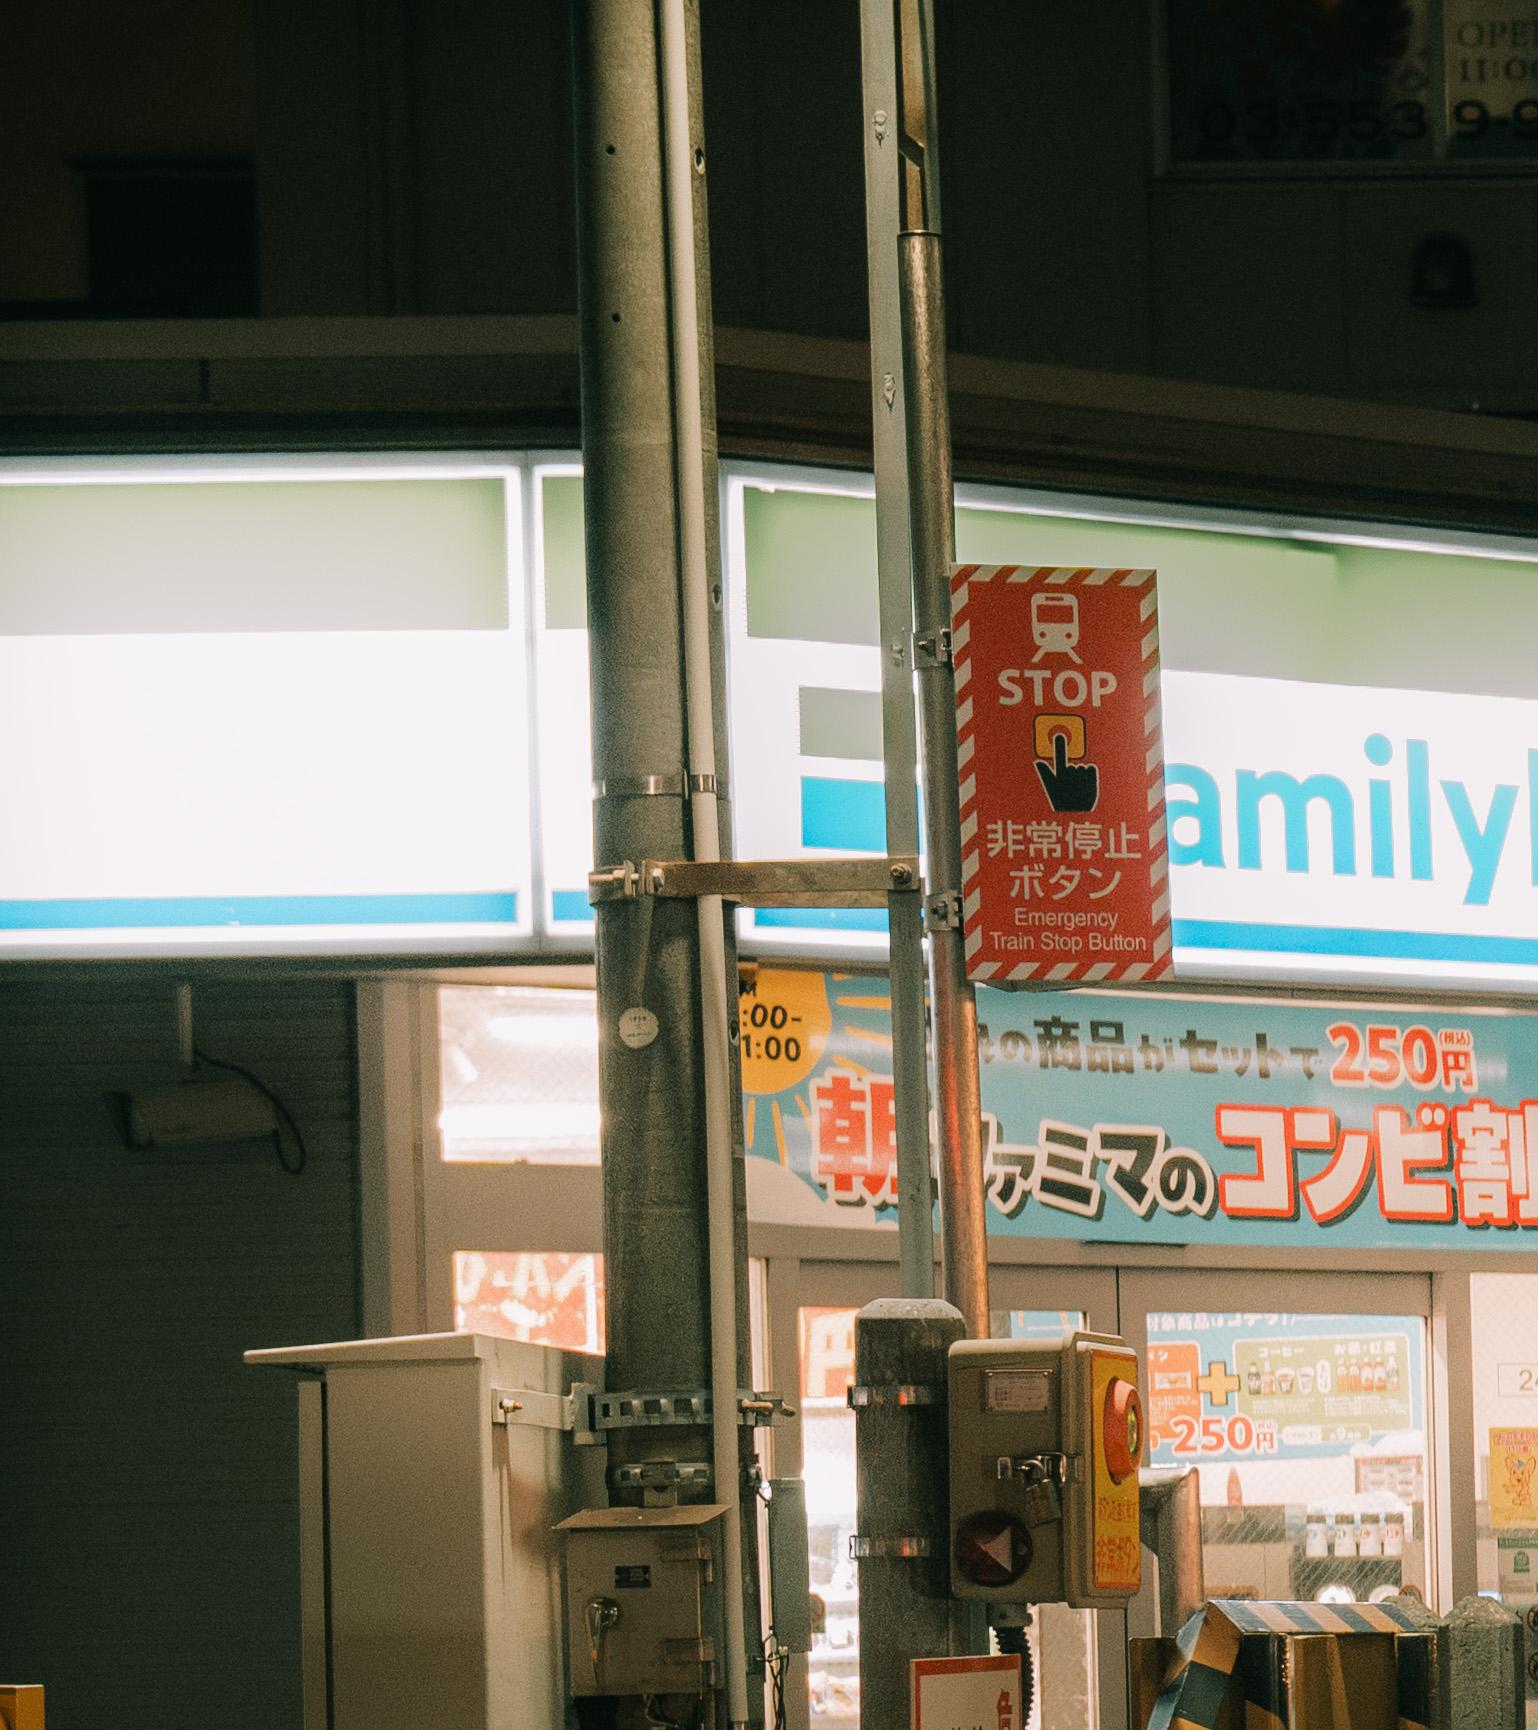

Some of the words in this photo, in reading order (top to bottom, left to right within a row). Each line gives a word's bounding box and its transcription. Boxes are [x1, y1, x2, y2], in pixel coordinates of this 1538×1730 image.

[998, 669, 1118, 707] STOP
[986, 820, 1142, 860] 非常停止
[1010, 865, 1122, 900] ボタン
[1014, 907, 1119, 932] Emergency
[989, 931, 1034, 950] Train
[1040, 932, 1082, 954] Stop
[1088, 932, 1147, 952] Button
[741, 1002, 803, 1030] :00-
[741, 1034, 801, 1062] 1:00
[1172, 1417, 1275, 1453] 250円
